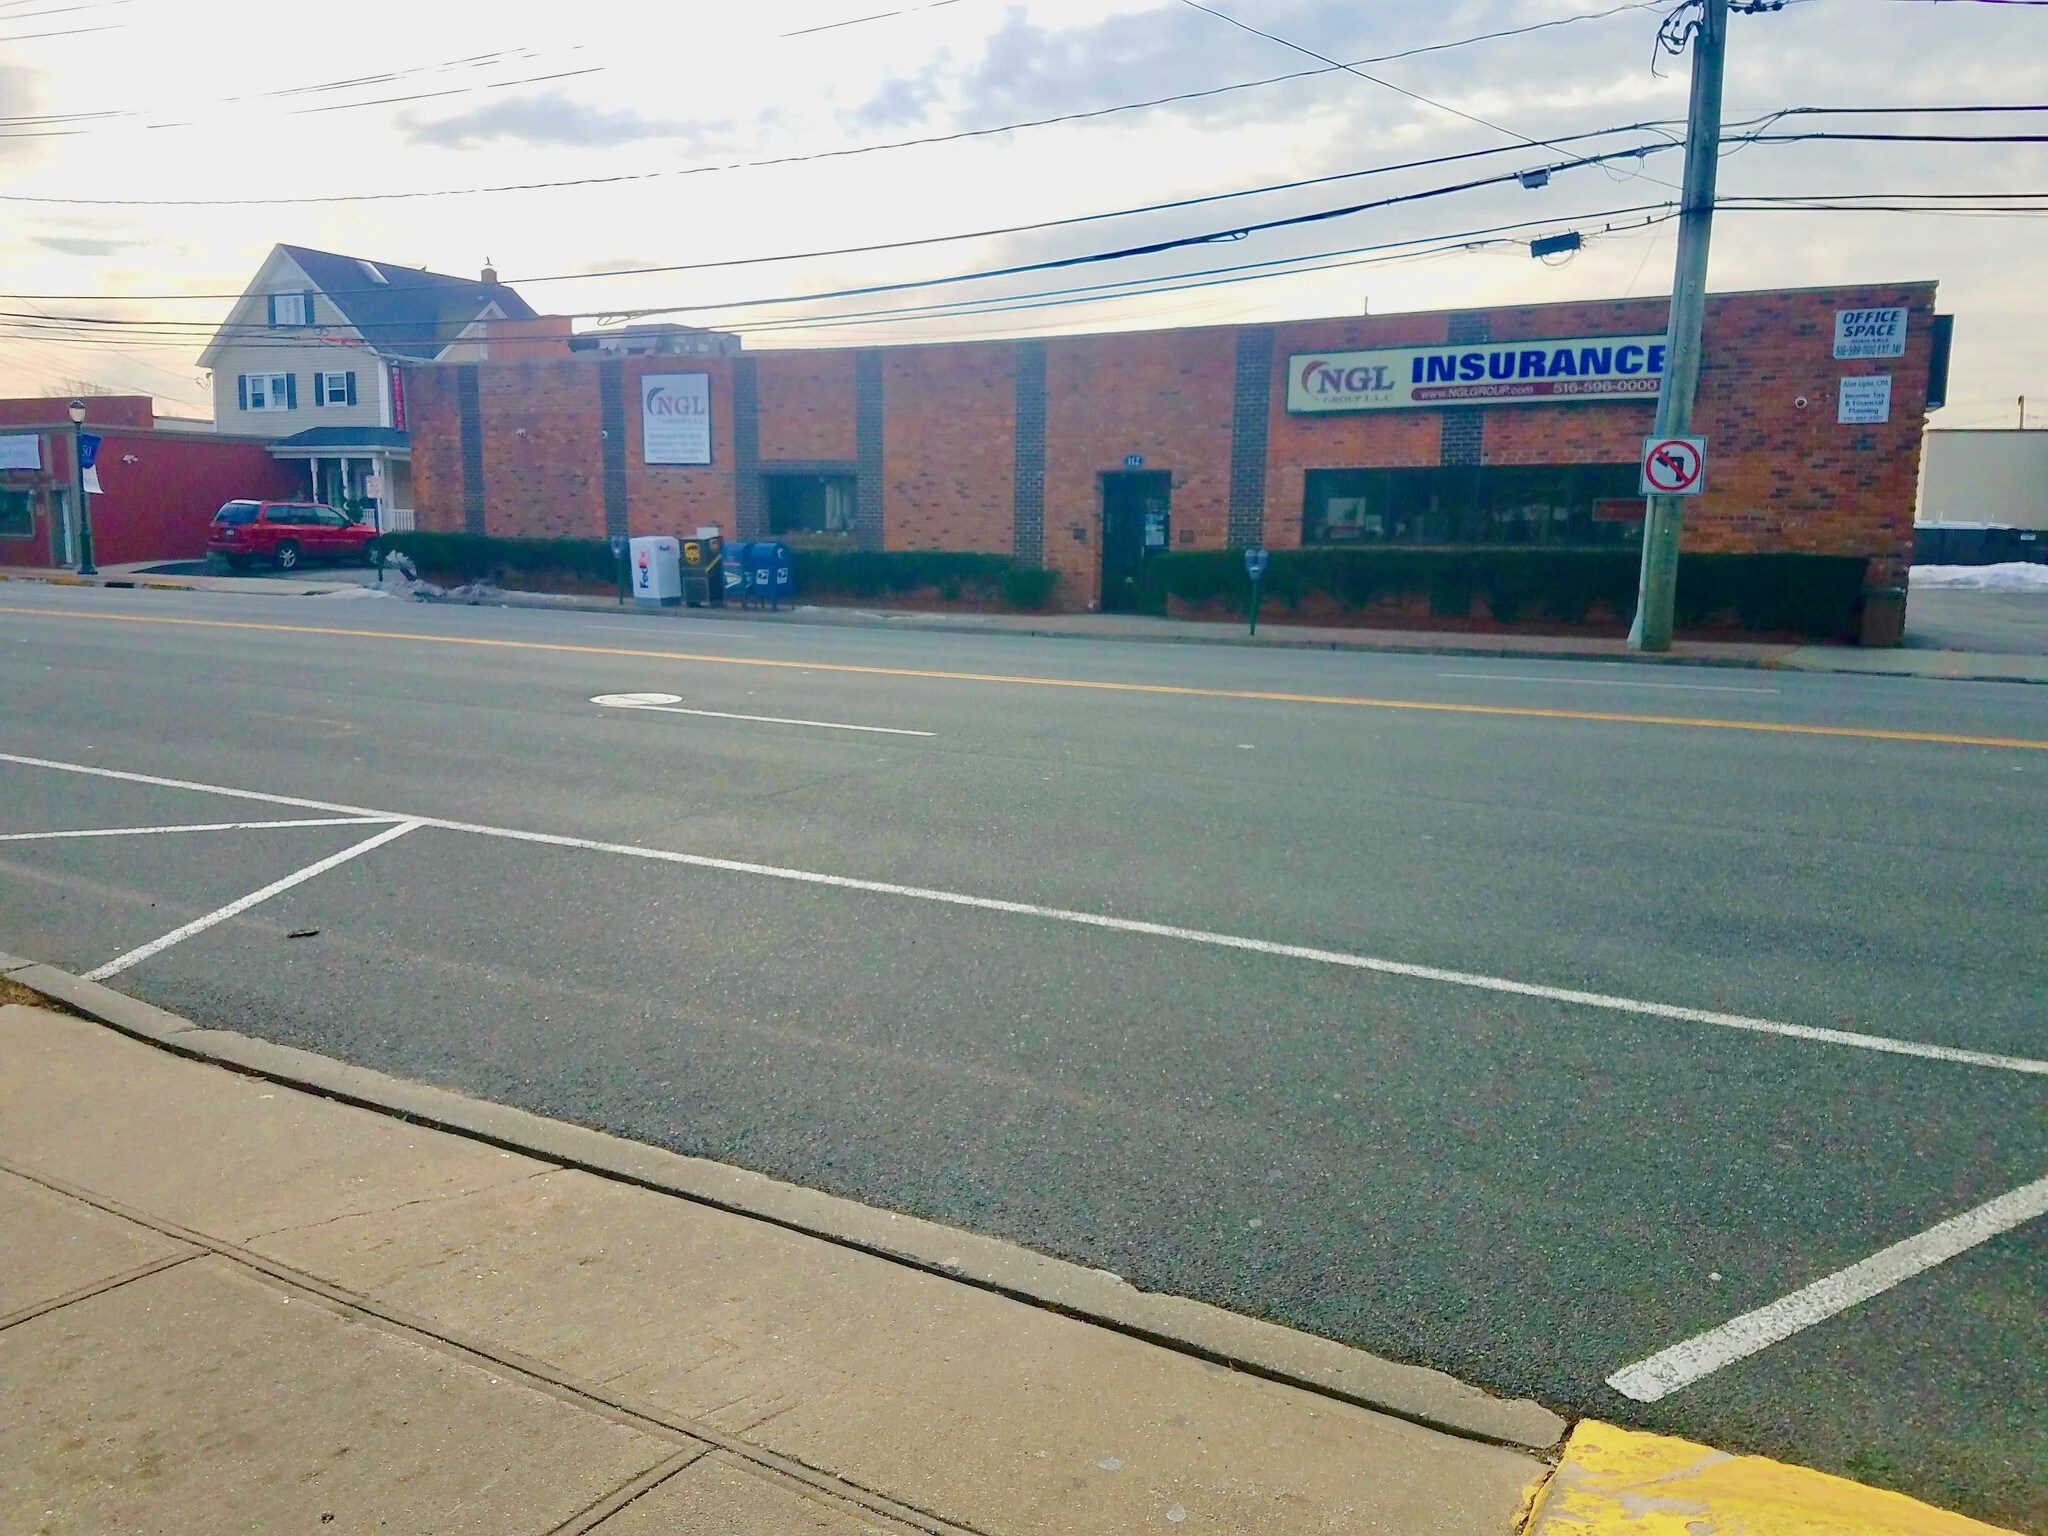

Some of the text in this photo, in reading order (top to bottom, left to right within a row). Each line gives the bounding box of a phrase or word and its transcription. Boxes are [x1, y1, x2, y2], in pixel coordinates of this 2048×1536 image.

[1843, 311, 1900, 324] OFFICE
[1843, 324, 1897, 337] SPACE
[1411, 344, 1666, 384] INSURANCE
[1317, 365, 1395, 393] NGL
[657, 395, 705, 416] NGL
[1323, 395, 1361, 403] GROUP
[638, 550, 649, 589] FedEx
